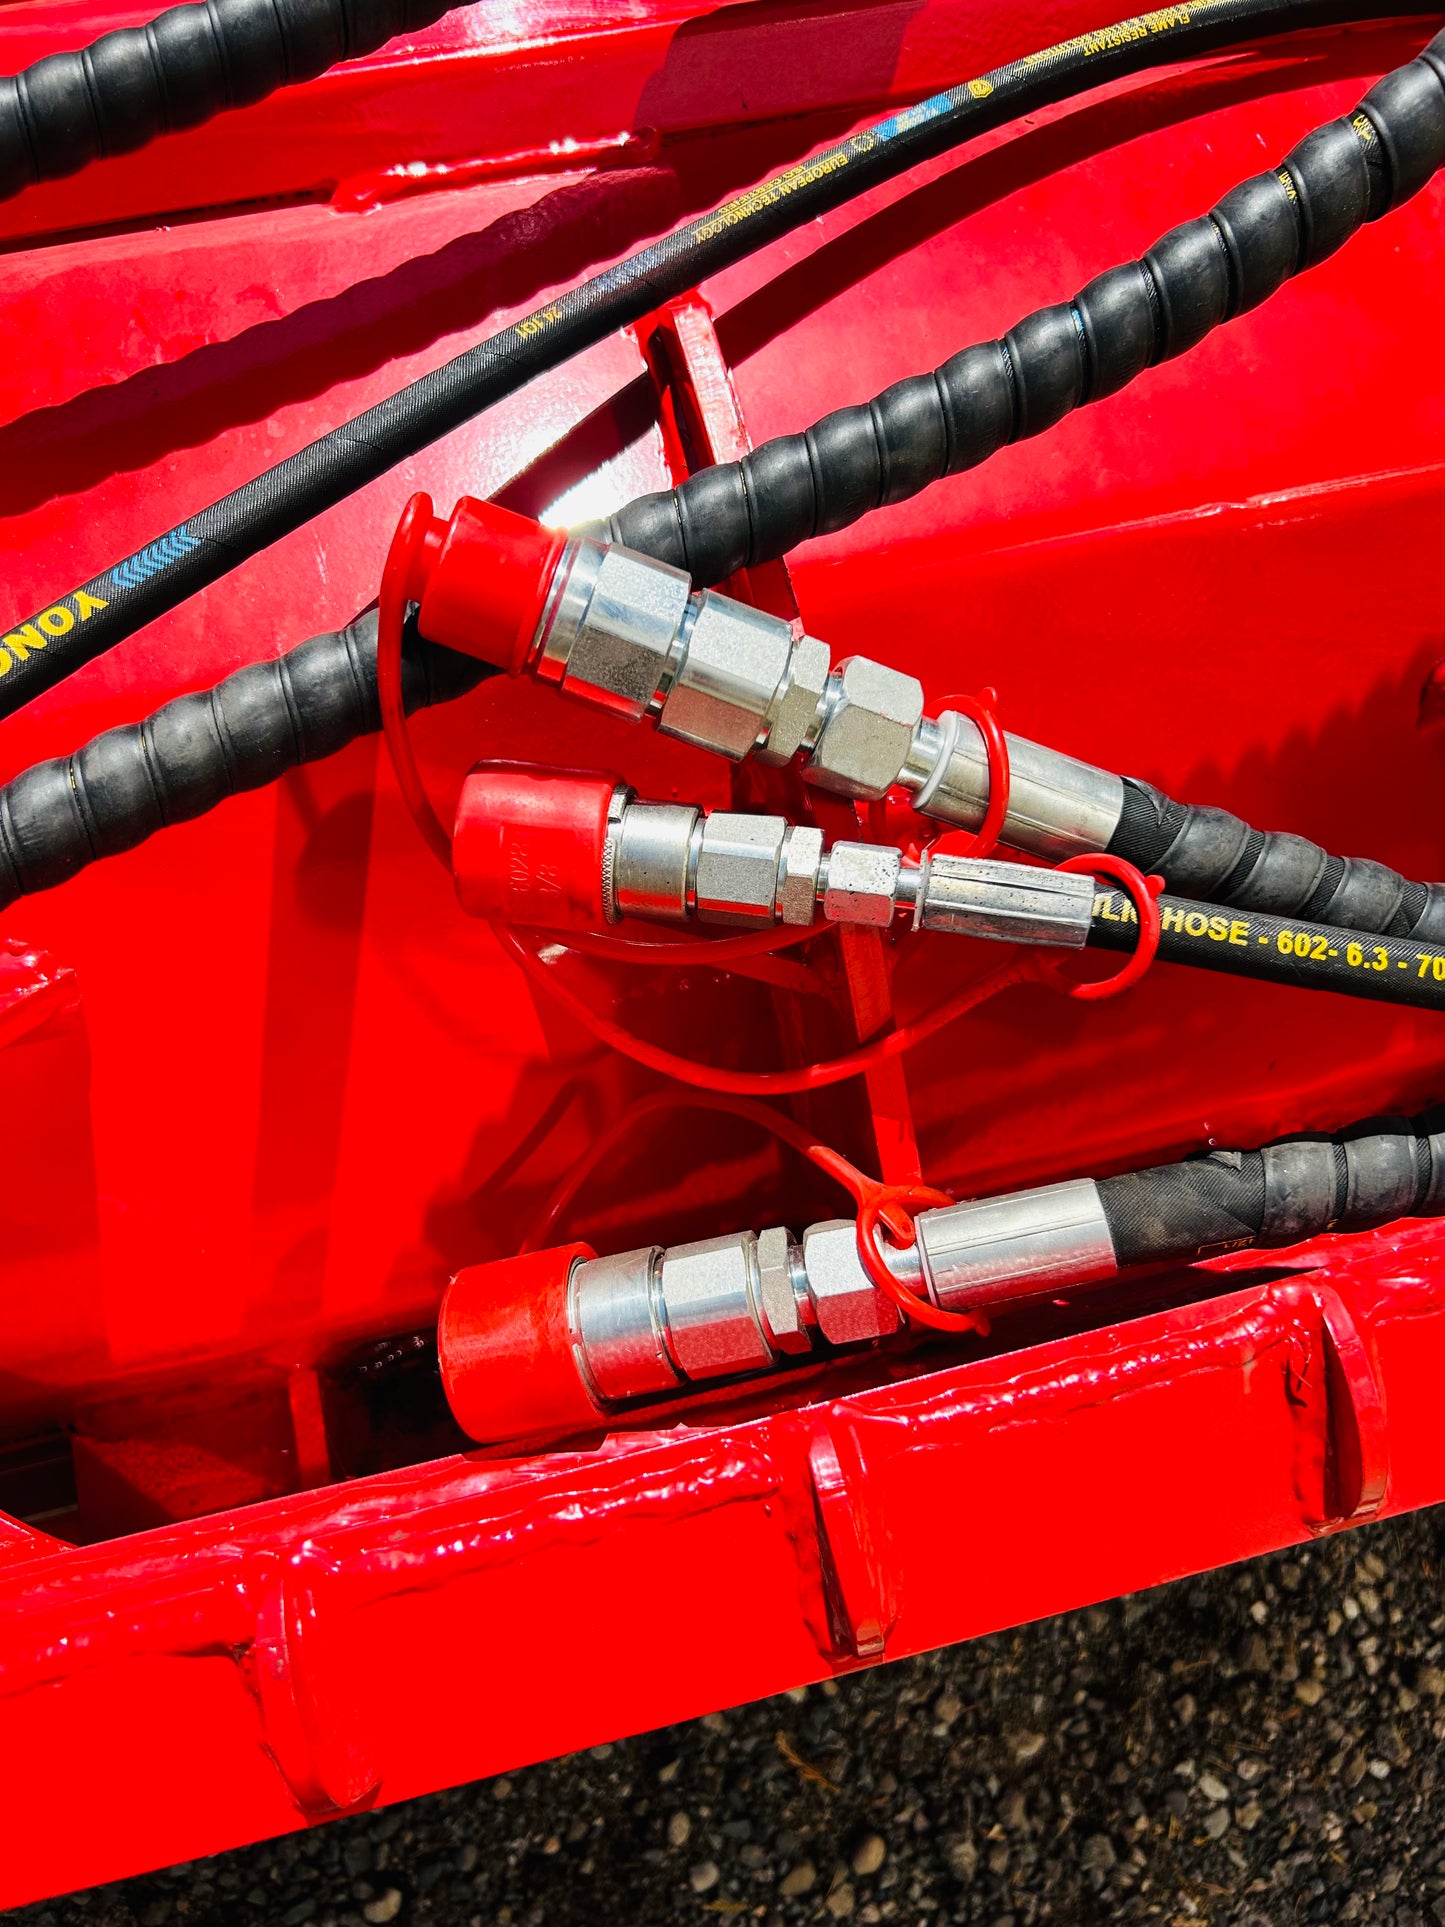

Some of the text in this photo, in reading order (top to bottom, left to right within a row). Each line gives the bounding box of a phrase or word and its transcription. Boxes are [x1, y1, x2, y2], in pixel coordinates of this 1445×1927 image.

[1084, 15, 1191, 56] FLAME RESISTANT
[695, 155, 848, 244] EUROPEAN TECHNOLOGY
[1162, 906, 1250, 947] HOSE
[1346, 944, 1388, 971] 6.3
